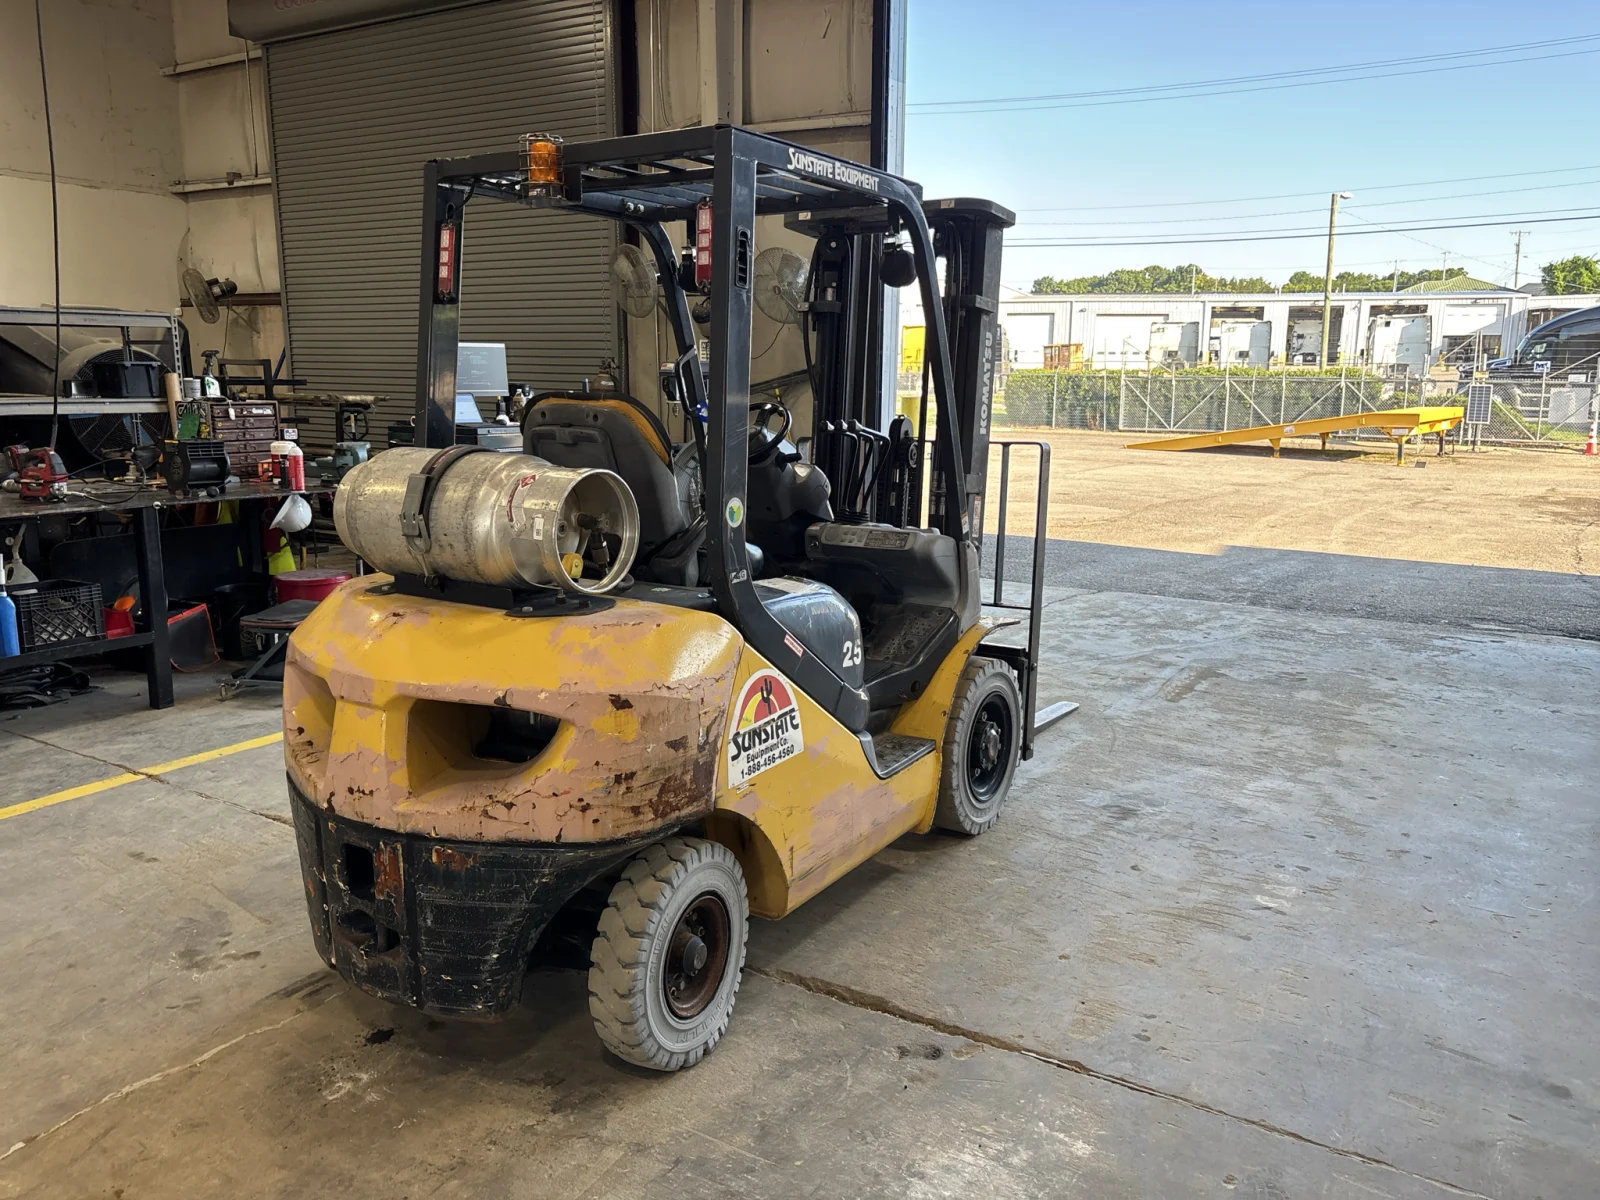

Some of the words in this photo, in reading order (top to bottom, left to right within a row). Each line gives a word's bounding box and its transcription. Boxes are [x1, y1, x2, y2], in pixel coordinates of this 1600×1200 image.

[787, 148, 833, 179] SUNSTATE
[835, 161, 879, 192] EQUIPMENT
[980, 331, 993, 435] KOMATSU
[842, 639, 862, 667] 25
[731, 707, 800, 762] SUNSTATE
[746, 741, 780, 764] Equipment
[741, 744, 795, 780] 1-888-456-4560
